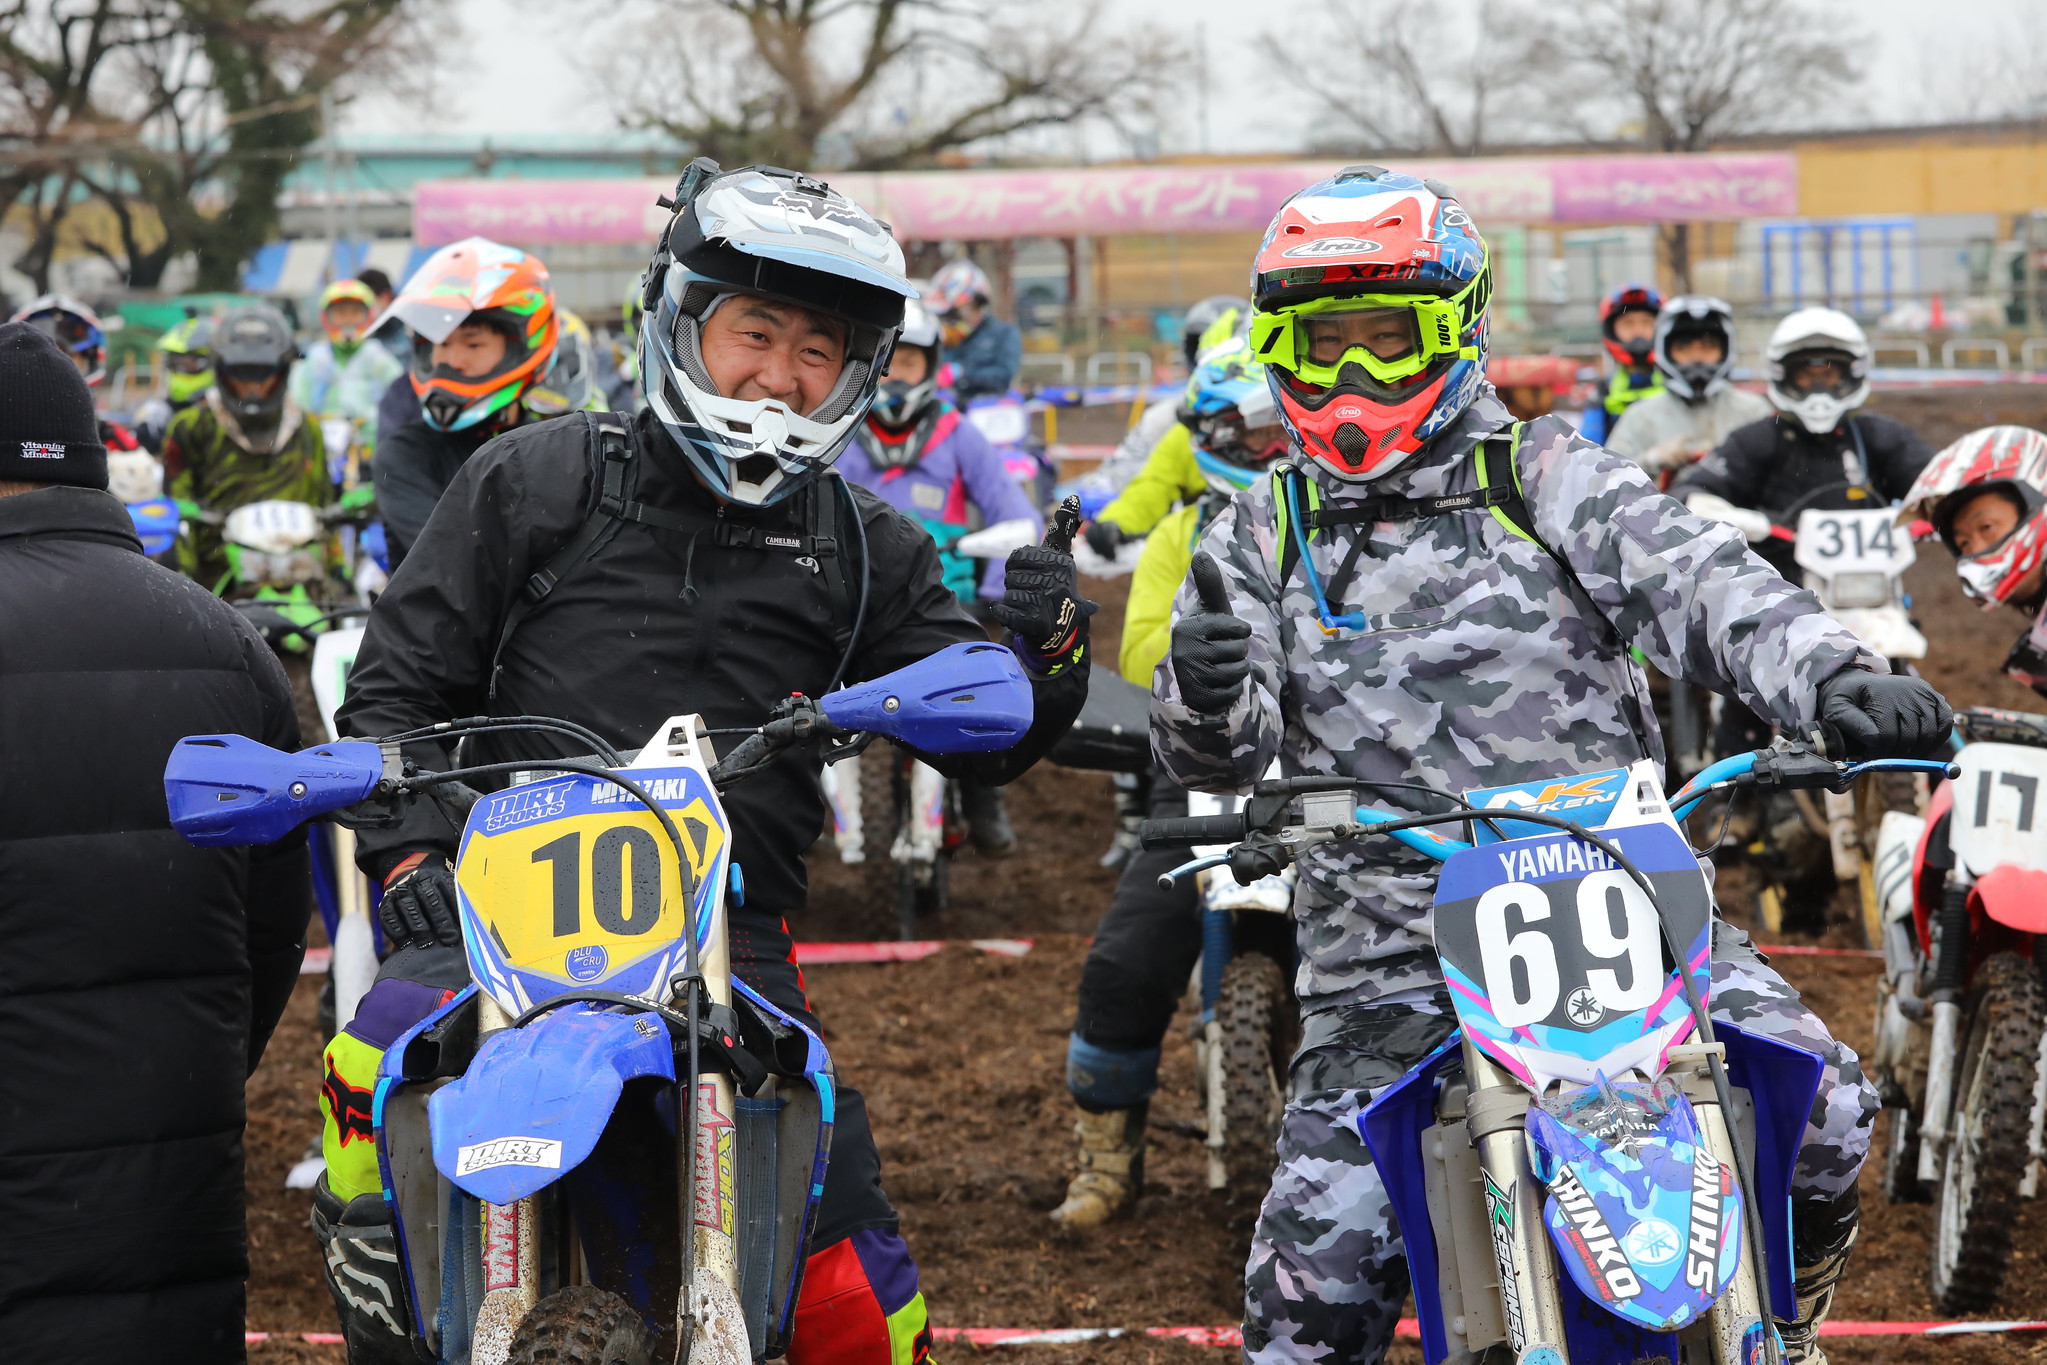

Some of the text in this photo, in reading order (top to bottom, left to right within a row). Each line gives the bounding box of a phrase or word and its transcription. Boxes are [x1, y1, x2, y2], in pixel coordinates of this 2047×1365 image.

[1458, 258, 1493, 328] 10
[1436, 313, 1451, 348] 100%
[20, 441, 66, 450] Vitamins
[20, 450, 65, 459] Minerals
[1816, 518, 1898, 558] 314
[486, 780, 578, 821] DIRT
[486, 801, 565, 832] SPORTS
[1498, 838, 1624, 883] YAMAHA
[531, 825, 662, 938] 10
[582, 956, 602, 967] CRU
[1475, 868, 1665, 1028] 69
[1588, 1118, 1661, 1138] YAMAHA
[465, 1140, 555, 1164] DIRT
[465, 1154, 541, 1172] SPORTS
[1548, 1164, 1641, 1299] SHINKO
[1686, 1145, 1720, 1295] SHINKO
[1568, 1229, 1614, 1300] MOTORCYCLE TIRES
